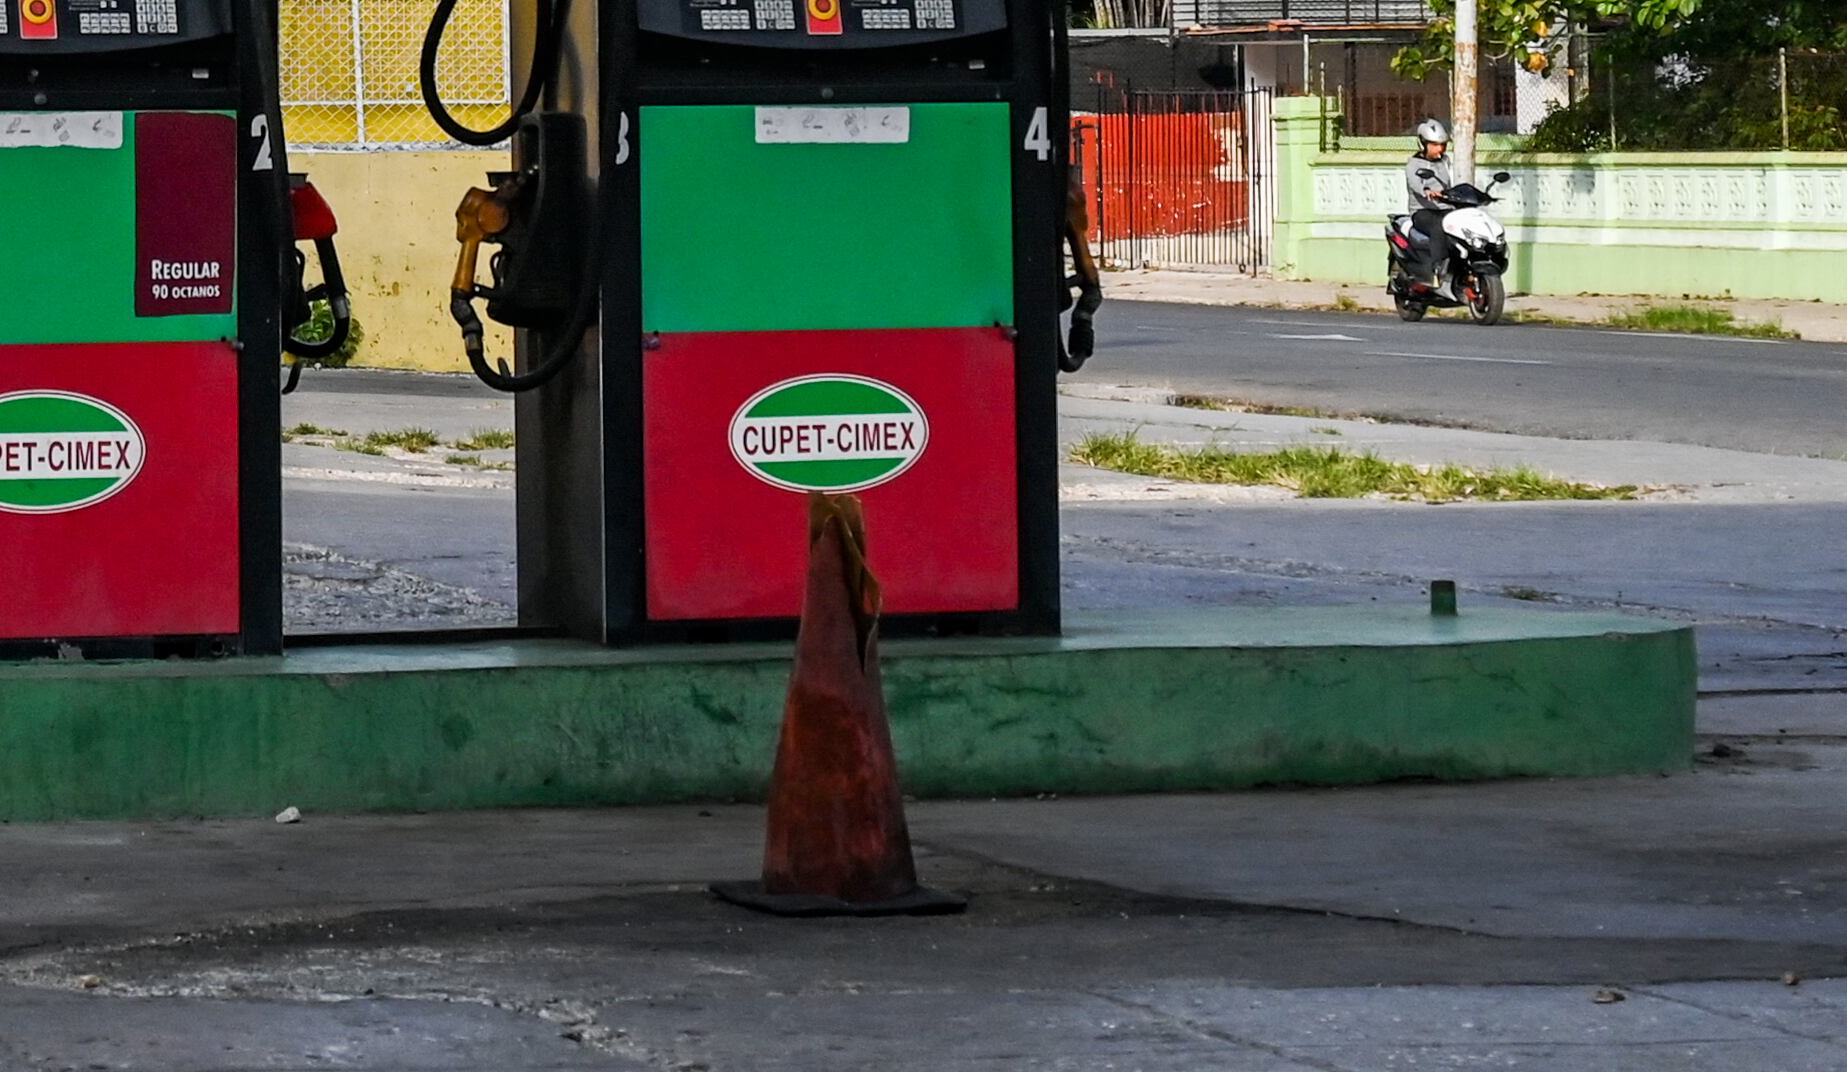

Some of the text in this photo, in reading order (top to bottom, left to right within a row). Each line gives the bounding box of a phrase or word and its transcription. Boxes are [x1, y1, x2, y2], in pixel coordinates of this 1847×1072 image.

[251, 113, 273, 171] 2
[1024, 106, 1051, 161] 4
[151, 258, 220, 281] REGULAR
[152, 283, 220, 300] 90 OCTANOS
[742, 419, 915, 455] CUPET-CIMEX
